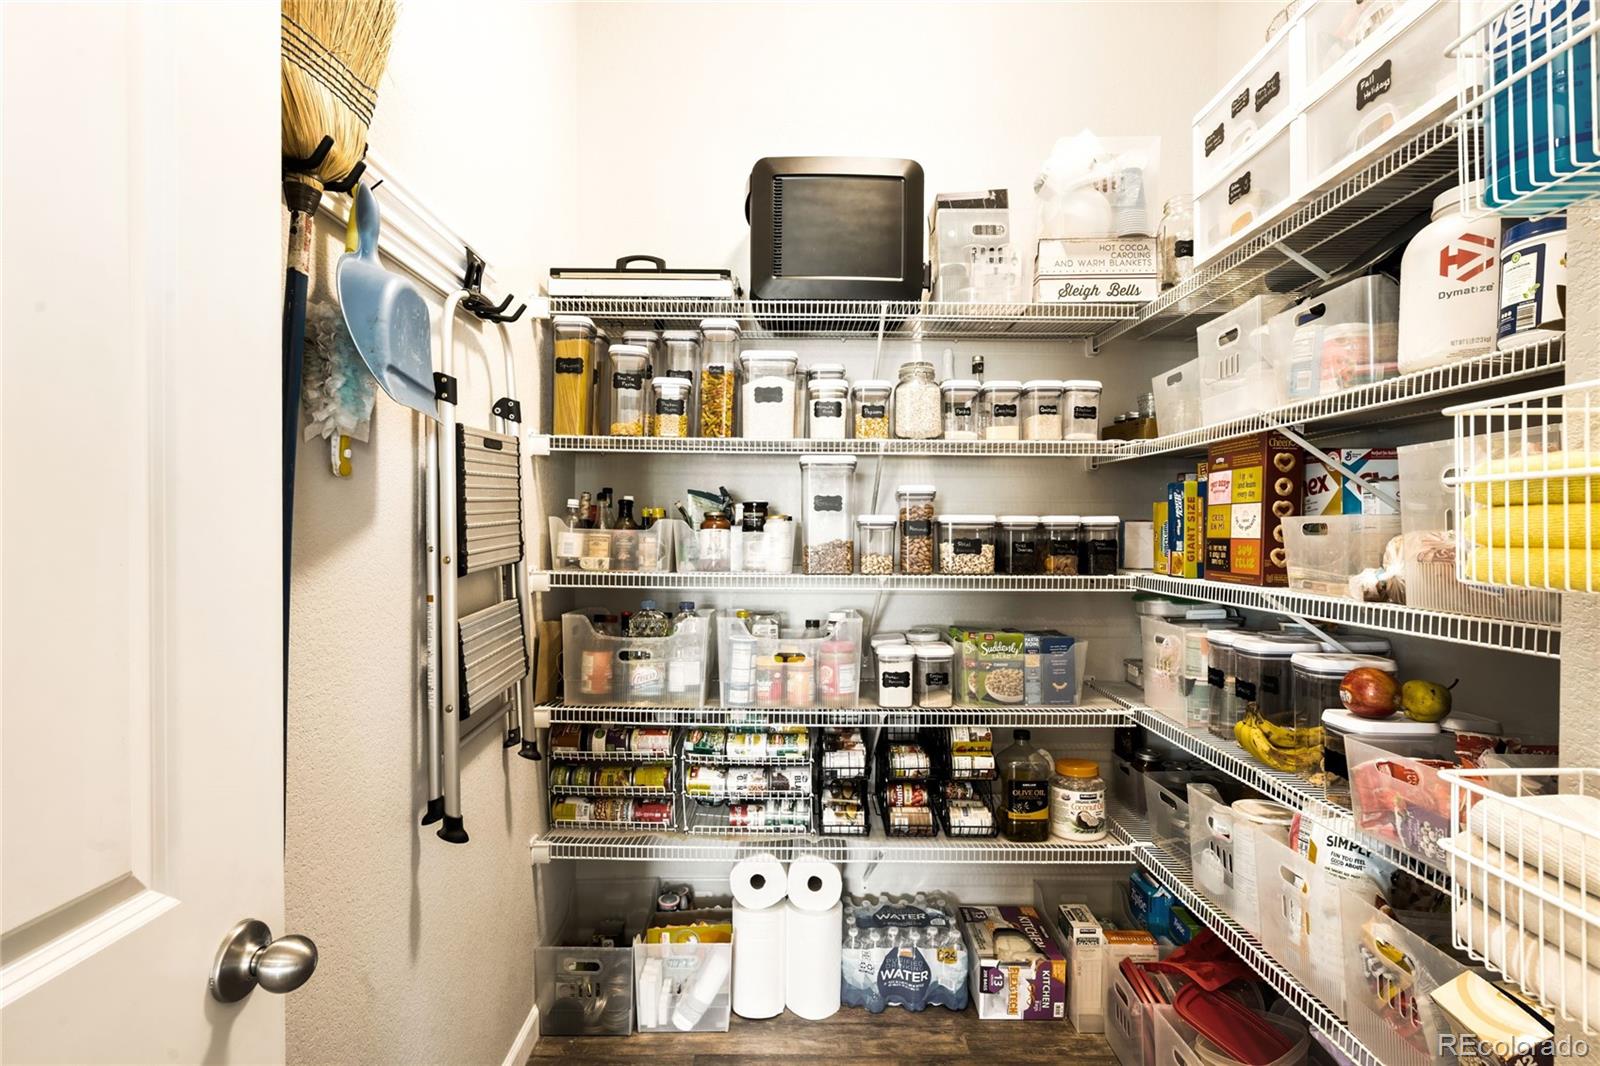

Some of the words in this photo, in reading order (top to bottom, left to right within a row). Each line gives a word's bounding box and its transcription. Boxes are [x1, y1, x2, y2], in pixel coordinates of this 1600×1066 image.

[1360, 74, 1375, 91] Fall
[1363, 77, 1391, 100] Holidays
[1099, 244, 1116, 252] HOT
[1110, 251, 1151, 259] CAROLING
[1054, 259, 1074, 267] AND
[1077, 259, 1106, 267] WARM
[1109, 258, 1153, 267] BLANKETS
[1058, 282, 1101, 300] Sleigh
[1106, 282, 1142, 297] Bells
[1438, 283, 1494, 300] Dymatize
[1187, 496, 1196, 522] SIZE
[1187, 526, 1196, 562] GIANT
[980, 640, 1024, 656] Suddenly!
[1012, 789, 1033, 797] OLIVE
[1034, 789, 1045, 797] OIL
[1330, 857, 1345, 866] GOOD
[1354, 858, 1366, 866] FEEL
[875, 912, 927, 921] WATER
[1018, 916, 1047, 949] KITCHEN
[880, 968, 929, 983] WATER
[993, 974, 1004, 987] 13
[1042, 970, 1051, 1009] KITCHEN
